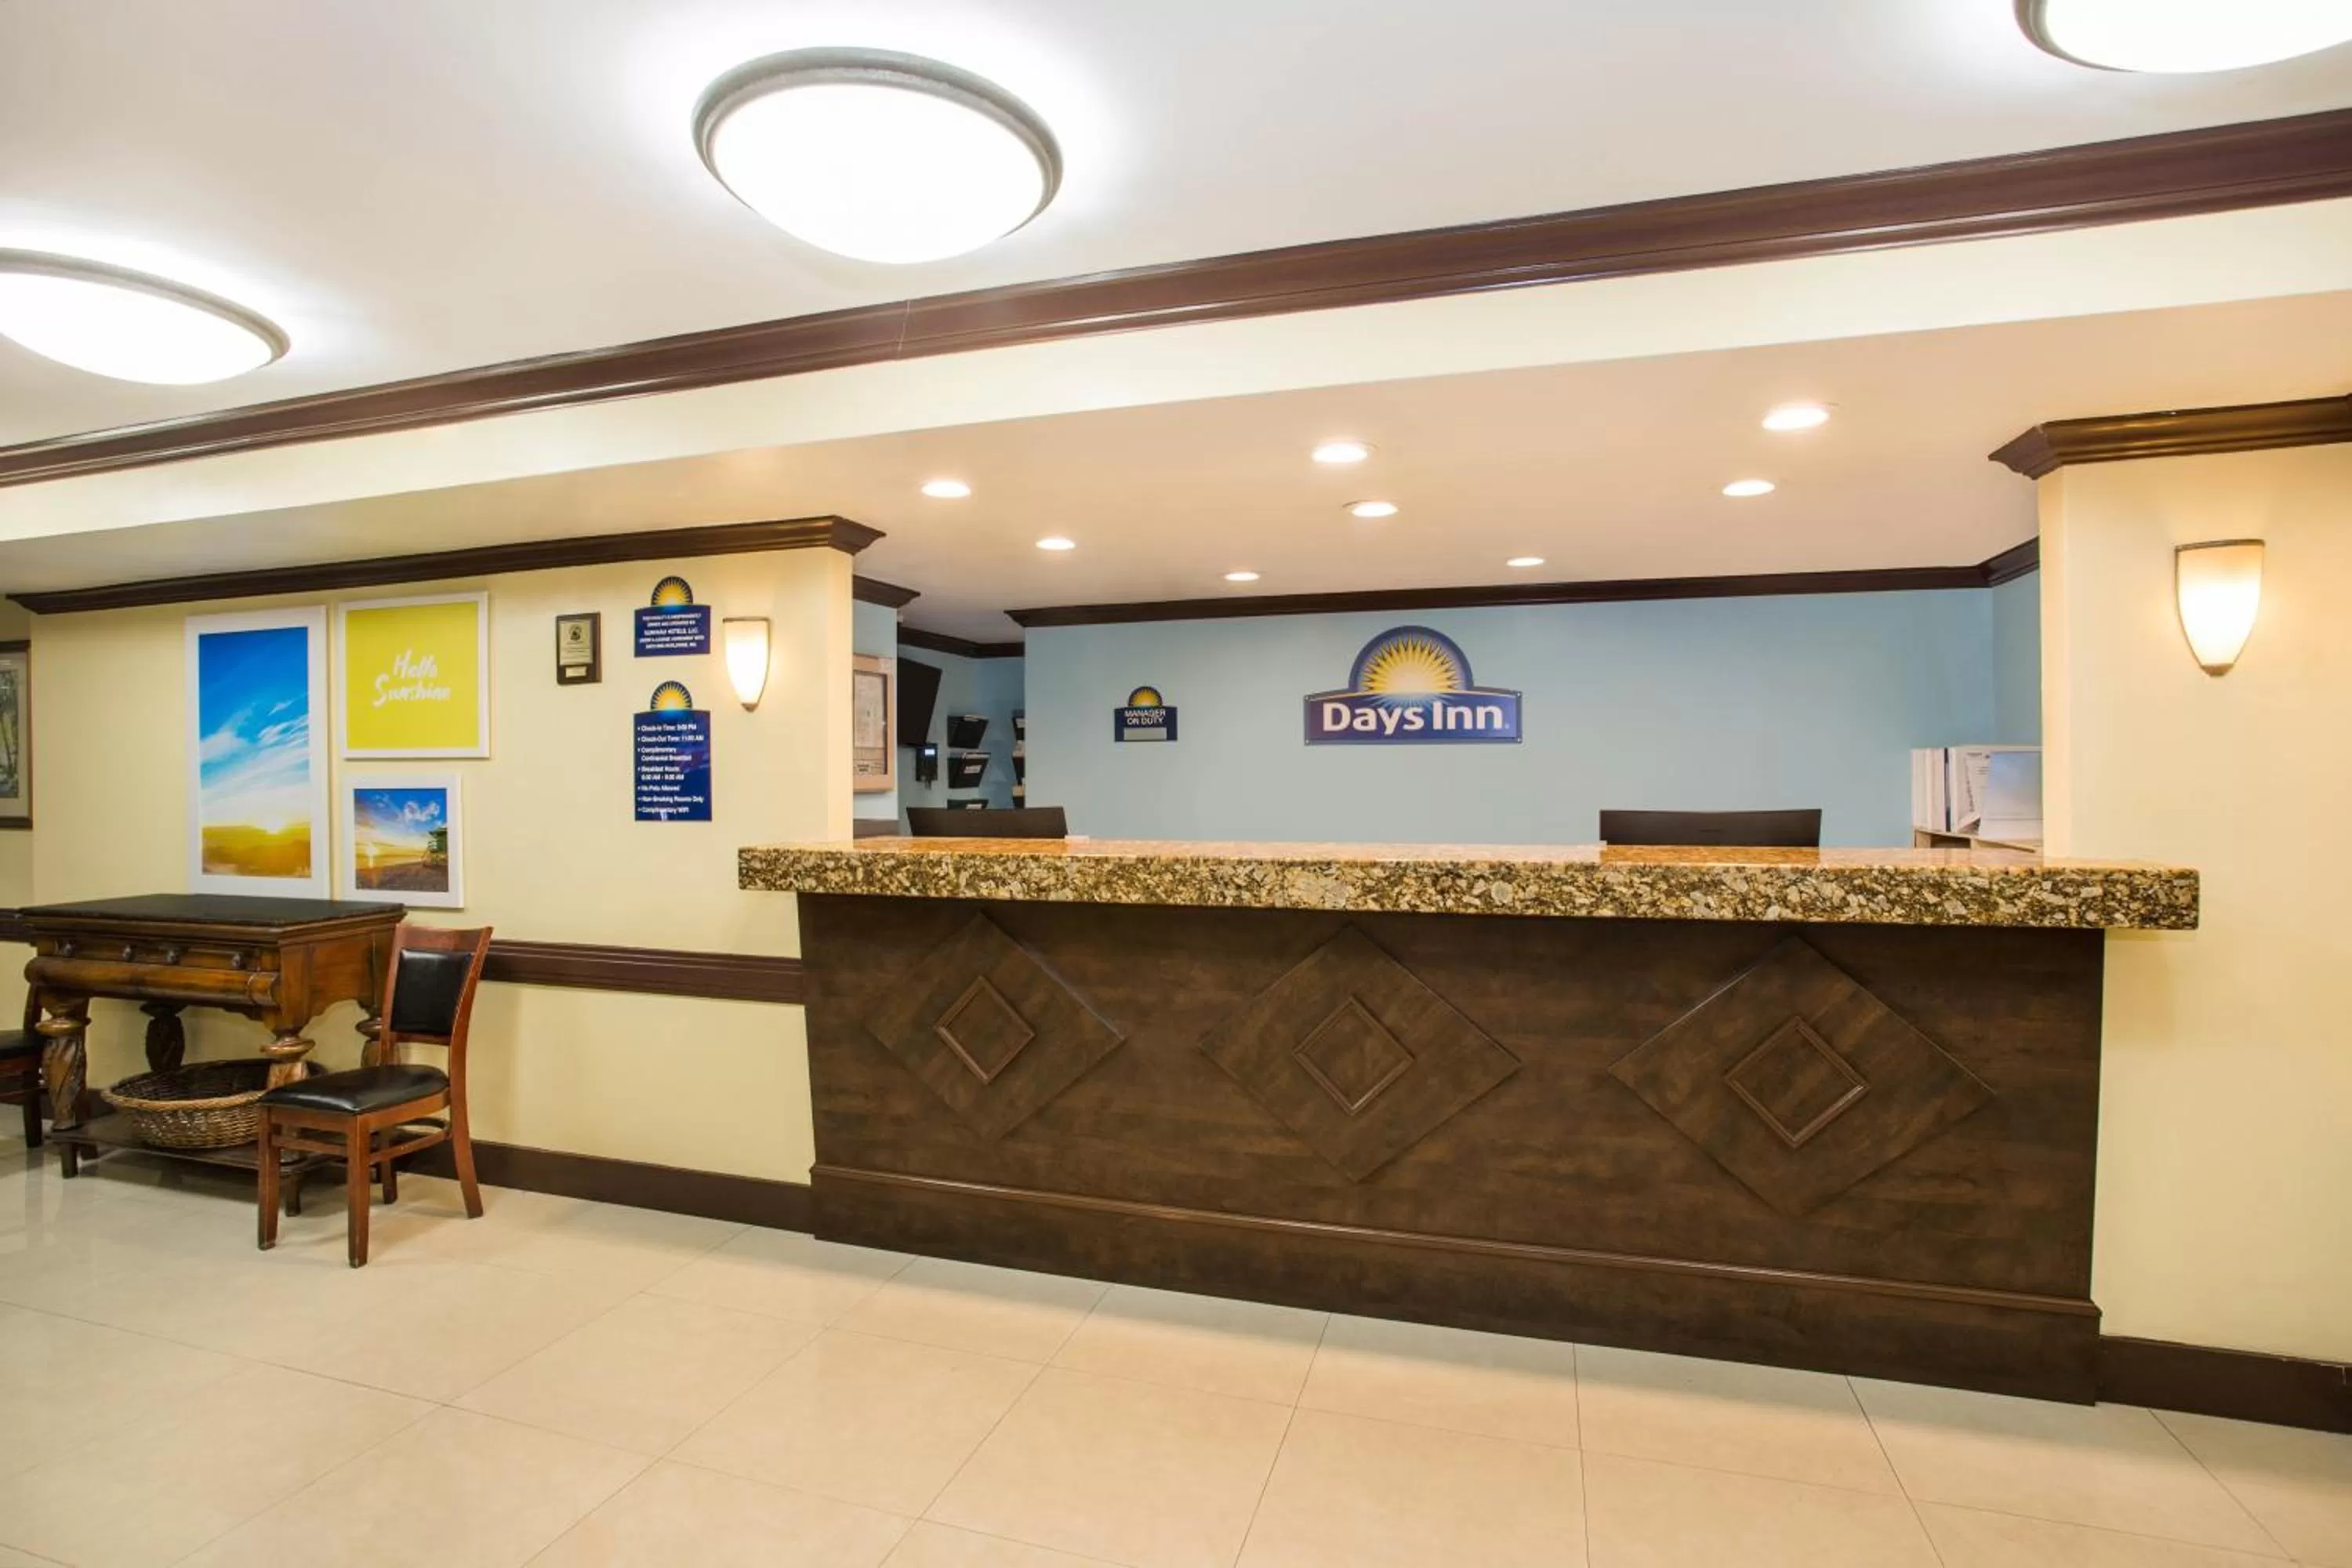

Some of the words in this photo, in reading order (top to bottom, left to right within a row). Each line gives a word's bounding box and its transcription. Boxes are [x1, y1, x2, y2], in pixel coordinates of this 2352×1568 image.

[393, 648, 438, 678] Hello
[372, 673, 452, 707] Sunshine
[1124, 709, 1166, 717] MANAGER
[1141, 716, 1164, 725] DUTY
[1322, 702, 1425, 735] Days
[1432, 701, 1503, 730] Inn
